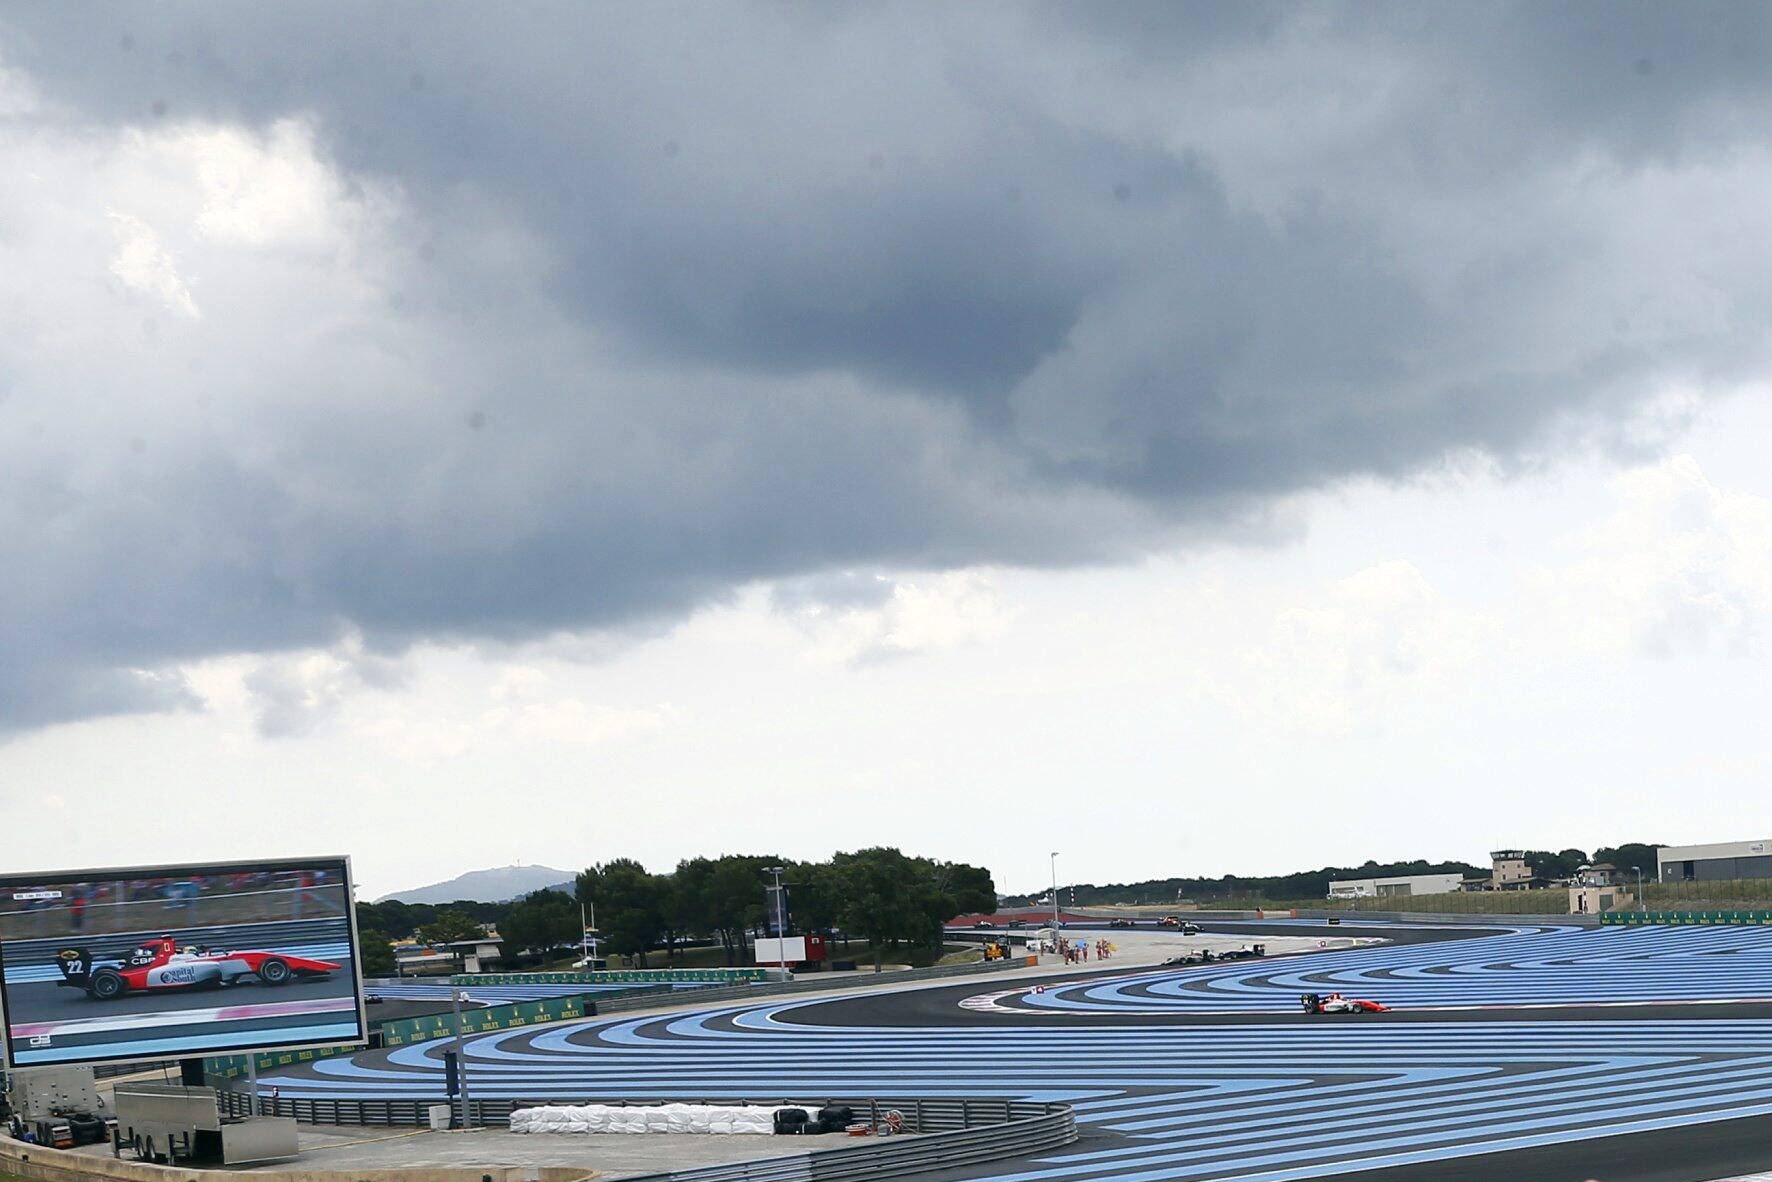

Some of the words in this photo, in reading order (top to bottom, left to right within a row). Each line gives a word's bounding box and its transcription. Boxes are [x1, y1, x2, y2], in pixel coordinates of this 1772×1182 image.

[67, 960, 84, 974] 22
[461, 1025, 475, 1034] OLEX
[509, 1017, 526, 1027] ROLEX
[534, 1013, 552, 1022] ROLEX
[561, 1009, 580, 1019] ROLEX
